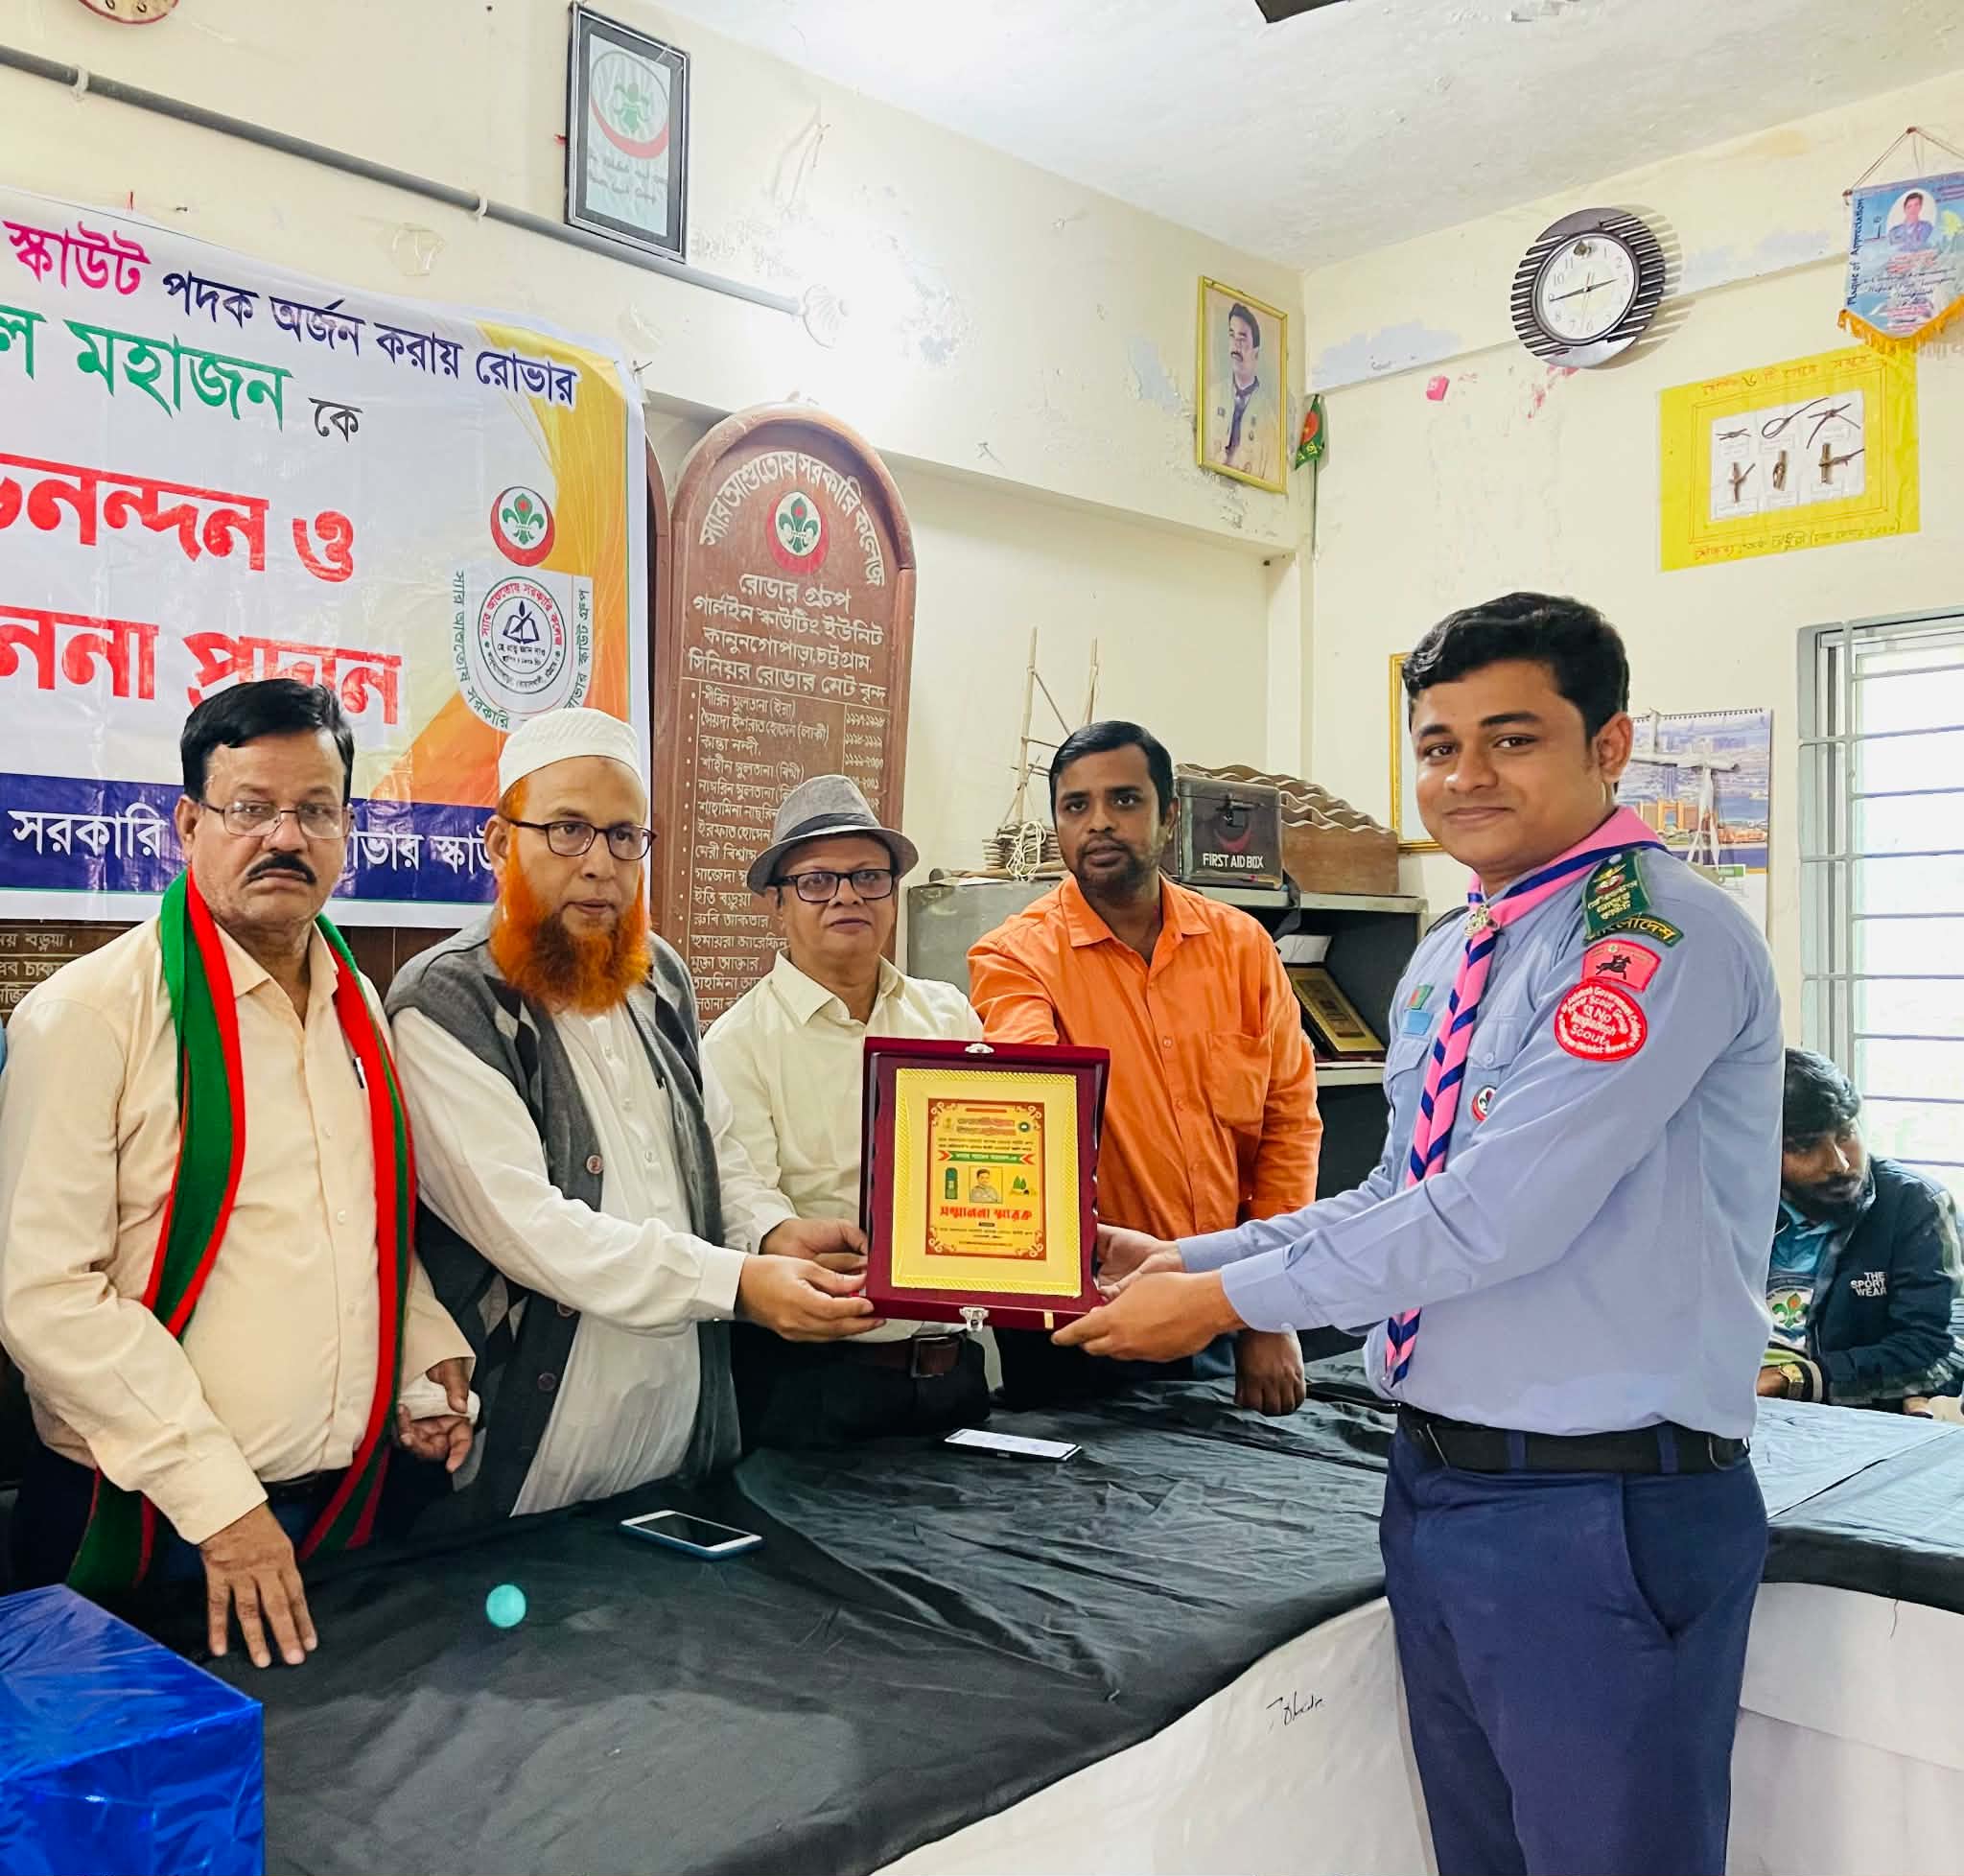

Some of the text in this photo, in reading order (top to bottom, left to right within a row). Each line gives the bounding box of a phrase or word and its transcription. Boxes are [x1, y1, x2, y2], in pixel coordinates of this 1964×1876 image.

[4, 220, 577, 407] স্কাউট পদক অর্জন করায় রোভার
[62, 318, 295, 432] মহাজন
[308, 397, 363, 442] কে
[798, 453, 863, 518] সরকারি
[854, 504, 886, 587] কলেজ
[292, 510, 354, 583] ও
[739, 574, 799, 604] রোভার
[822, 616, 884, 646] ইউনিট
[756, 663, 815, 692] রোভার
[8, 802, 167, 859] সরকারি
[1203, 853, 1264, 869] FIRST AID BOX
[1850, 1279, 1885, 1290] SPORT
[1863, 1272, 1887, 1280] THE
